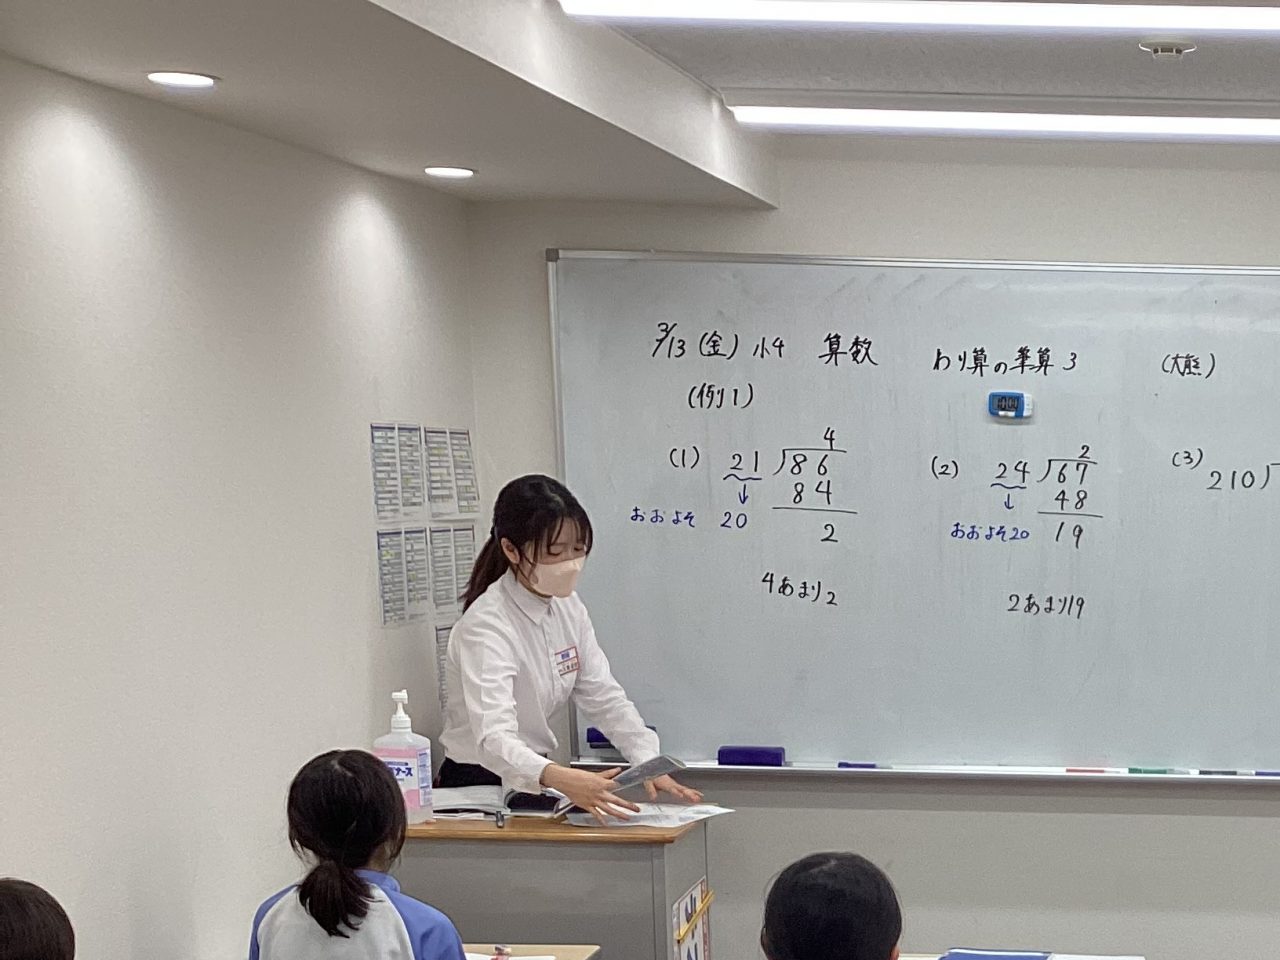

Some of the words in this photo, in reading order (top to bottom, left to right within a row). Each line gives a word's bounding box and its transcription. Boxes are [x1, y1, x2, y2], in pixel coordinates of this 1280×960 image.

[817, 332, 879, 367] 算数
[823, 426, 837, 449] 4
[669, 445, 700, 470] (1)
[1077, 444, 1091, 460] 2
[1171, 447, 1204, 471] (3)
[931, 455, 959, 480] (2)
[792, 479, 833, 506] 84
[1054, 489, 1088, 511] 48
[820, 523, 839, 543] 2
[1055, 521, 1084, 550] 19
